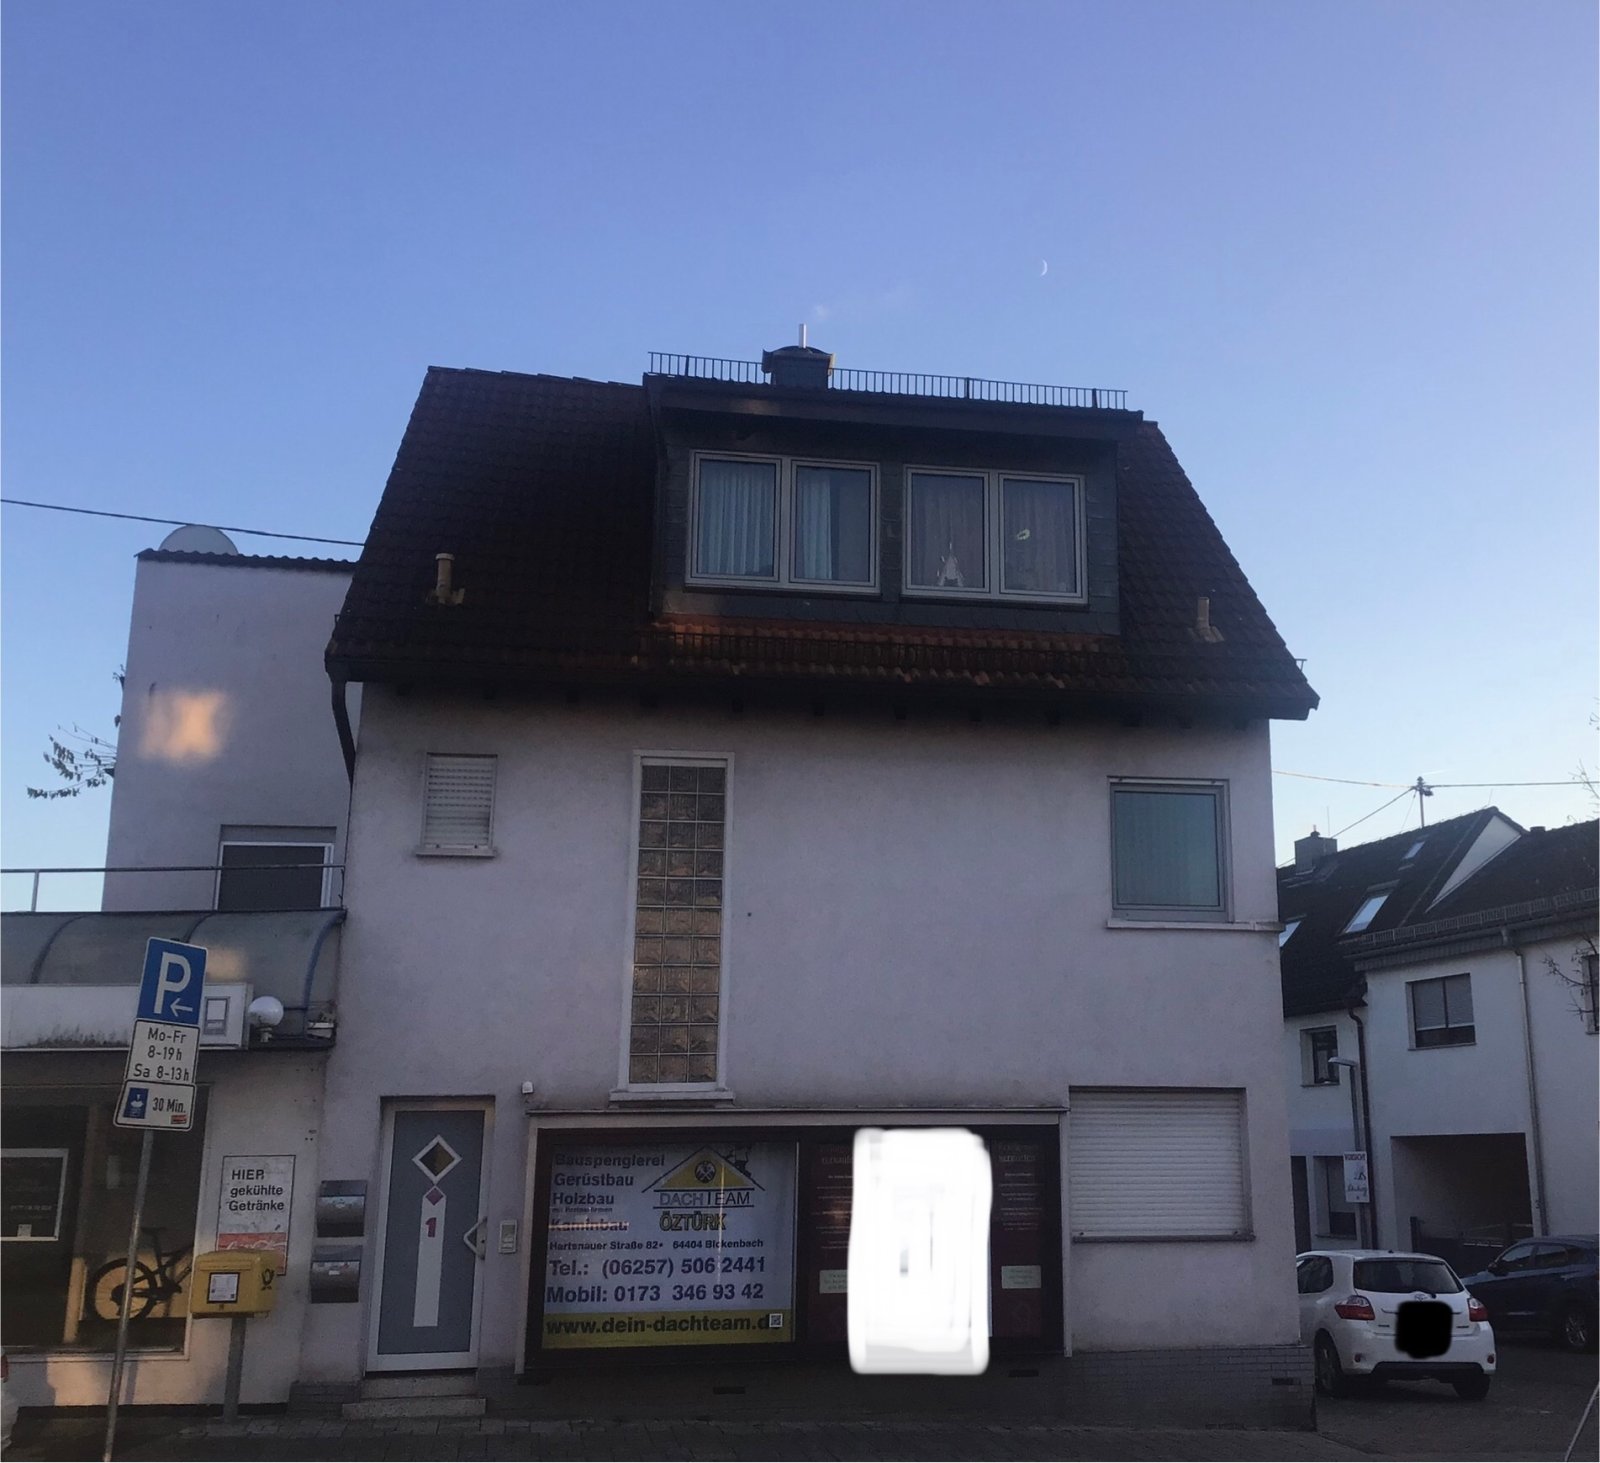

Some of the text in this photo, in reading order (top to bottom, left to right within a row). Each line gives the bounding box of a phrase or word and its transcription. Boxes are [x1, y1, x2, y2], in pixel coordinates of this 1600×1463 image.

[153, 951, 191, 1014] P
[148, 1028, 187, 1044] Mo-Fr
[133, 1063, 151, 1078] Sa
[153, 1097, 186, 1113] 30 Min.
[555, 1153, 665, 1169] Bauspenglerei
[231, 1169, 264, 1180] HIER
[554, 1172, 634, 1187] Gerüstbau
[230, 1186, 283, 1198] gekühlte
[552, 1191, 615, 1206] Holzbau
[229, 1199, 285, 1212] Getränke
[425, 1217, 437, 1238] 1
[660, 1210, 727, 1231] ÖZTÜRK
[610, 1239, 643, 1250] Straße
[672, 1239, 703, 1250] 64404
[550, 1256, 766, 1279] Tel.: (06257) 506 2441
[547, 1282, 764, 1304] Mobil: 0173 346 93 42
